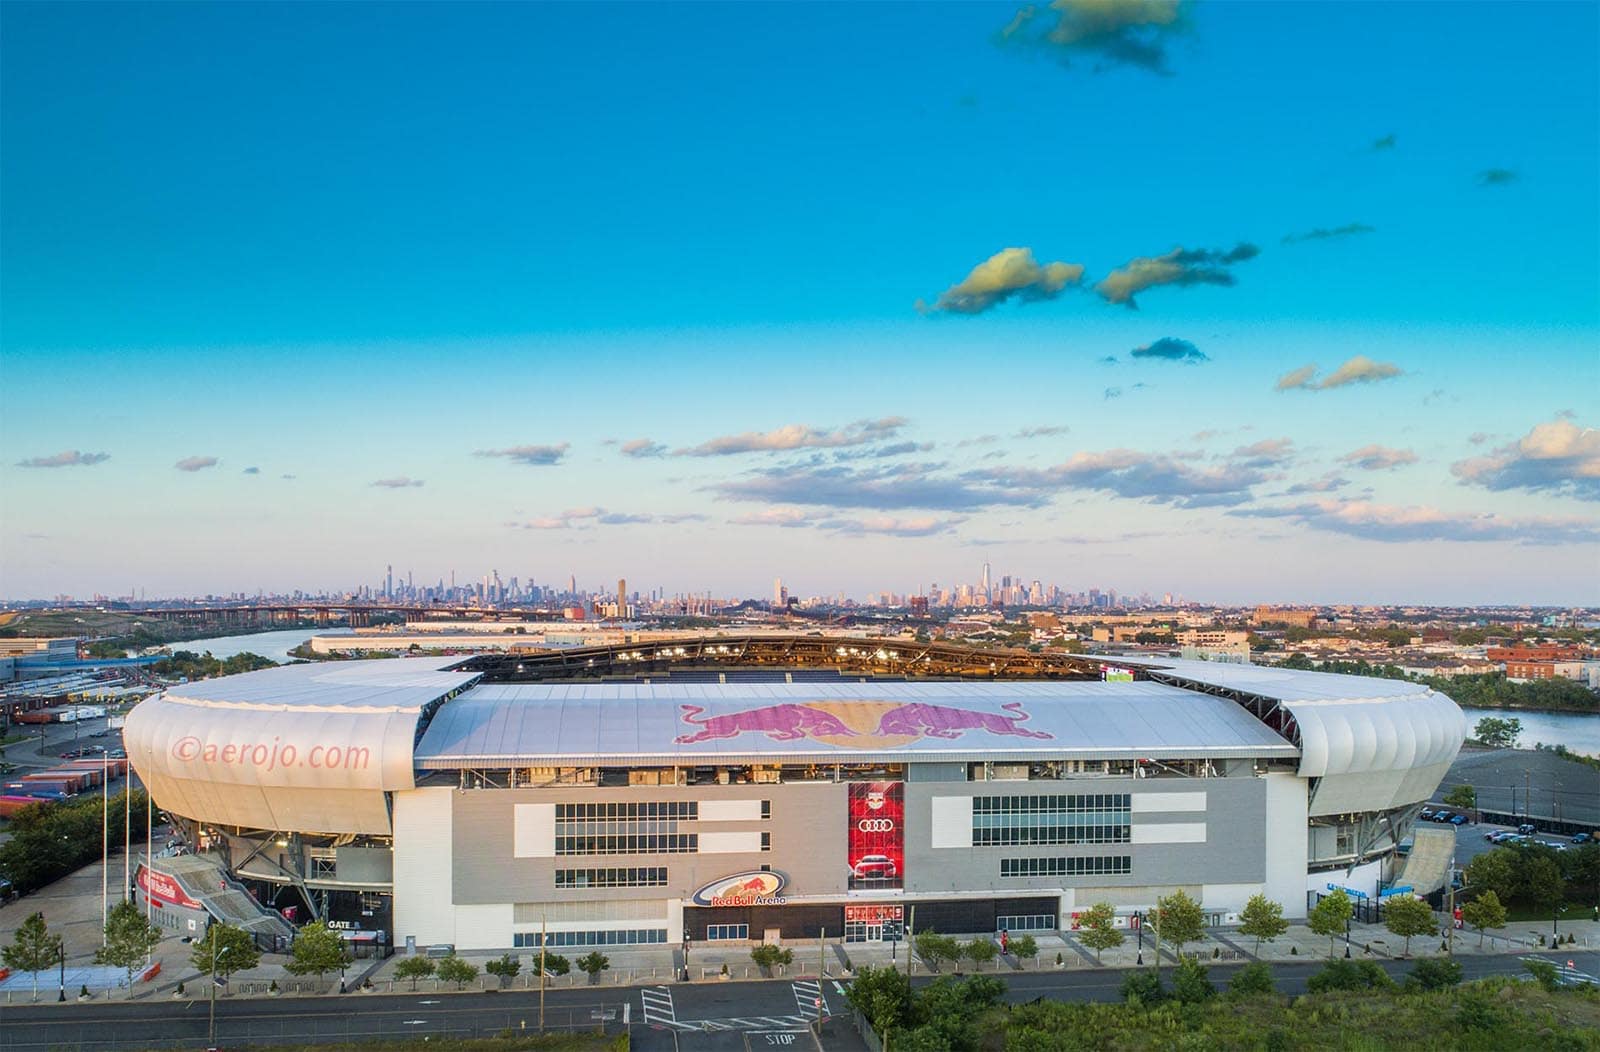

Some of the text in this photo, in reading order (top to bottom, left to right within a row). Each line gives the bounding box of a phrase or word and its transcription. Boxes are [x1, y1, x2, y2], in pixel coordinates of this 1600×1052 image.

[712, 895, 786, 906] Red Bull Arena
[328, 920, 351, 929] GATE
[765, 1034, 796, 1045] STOP
